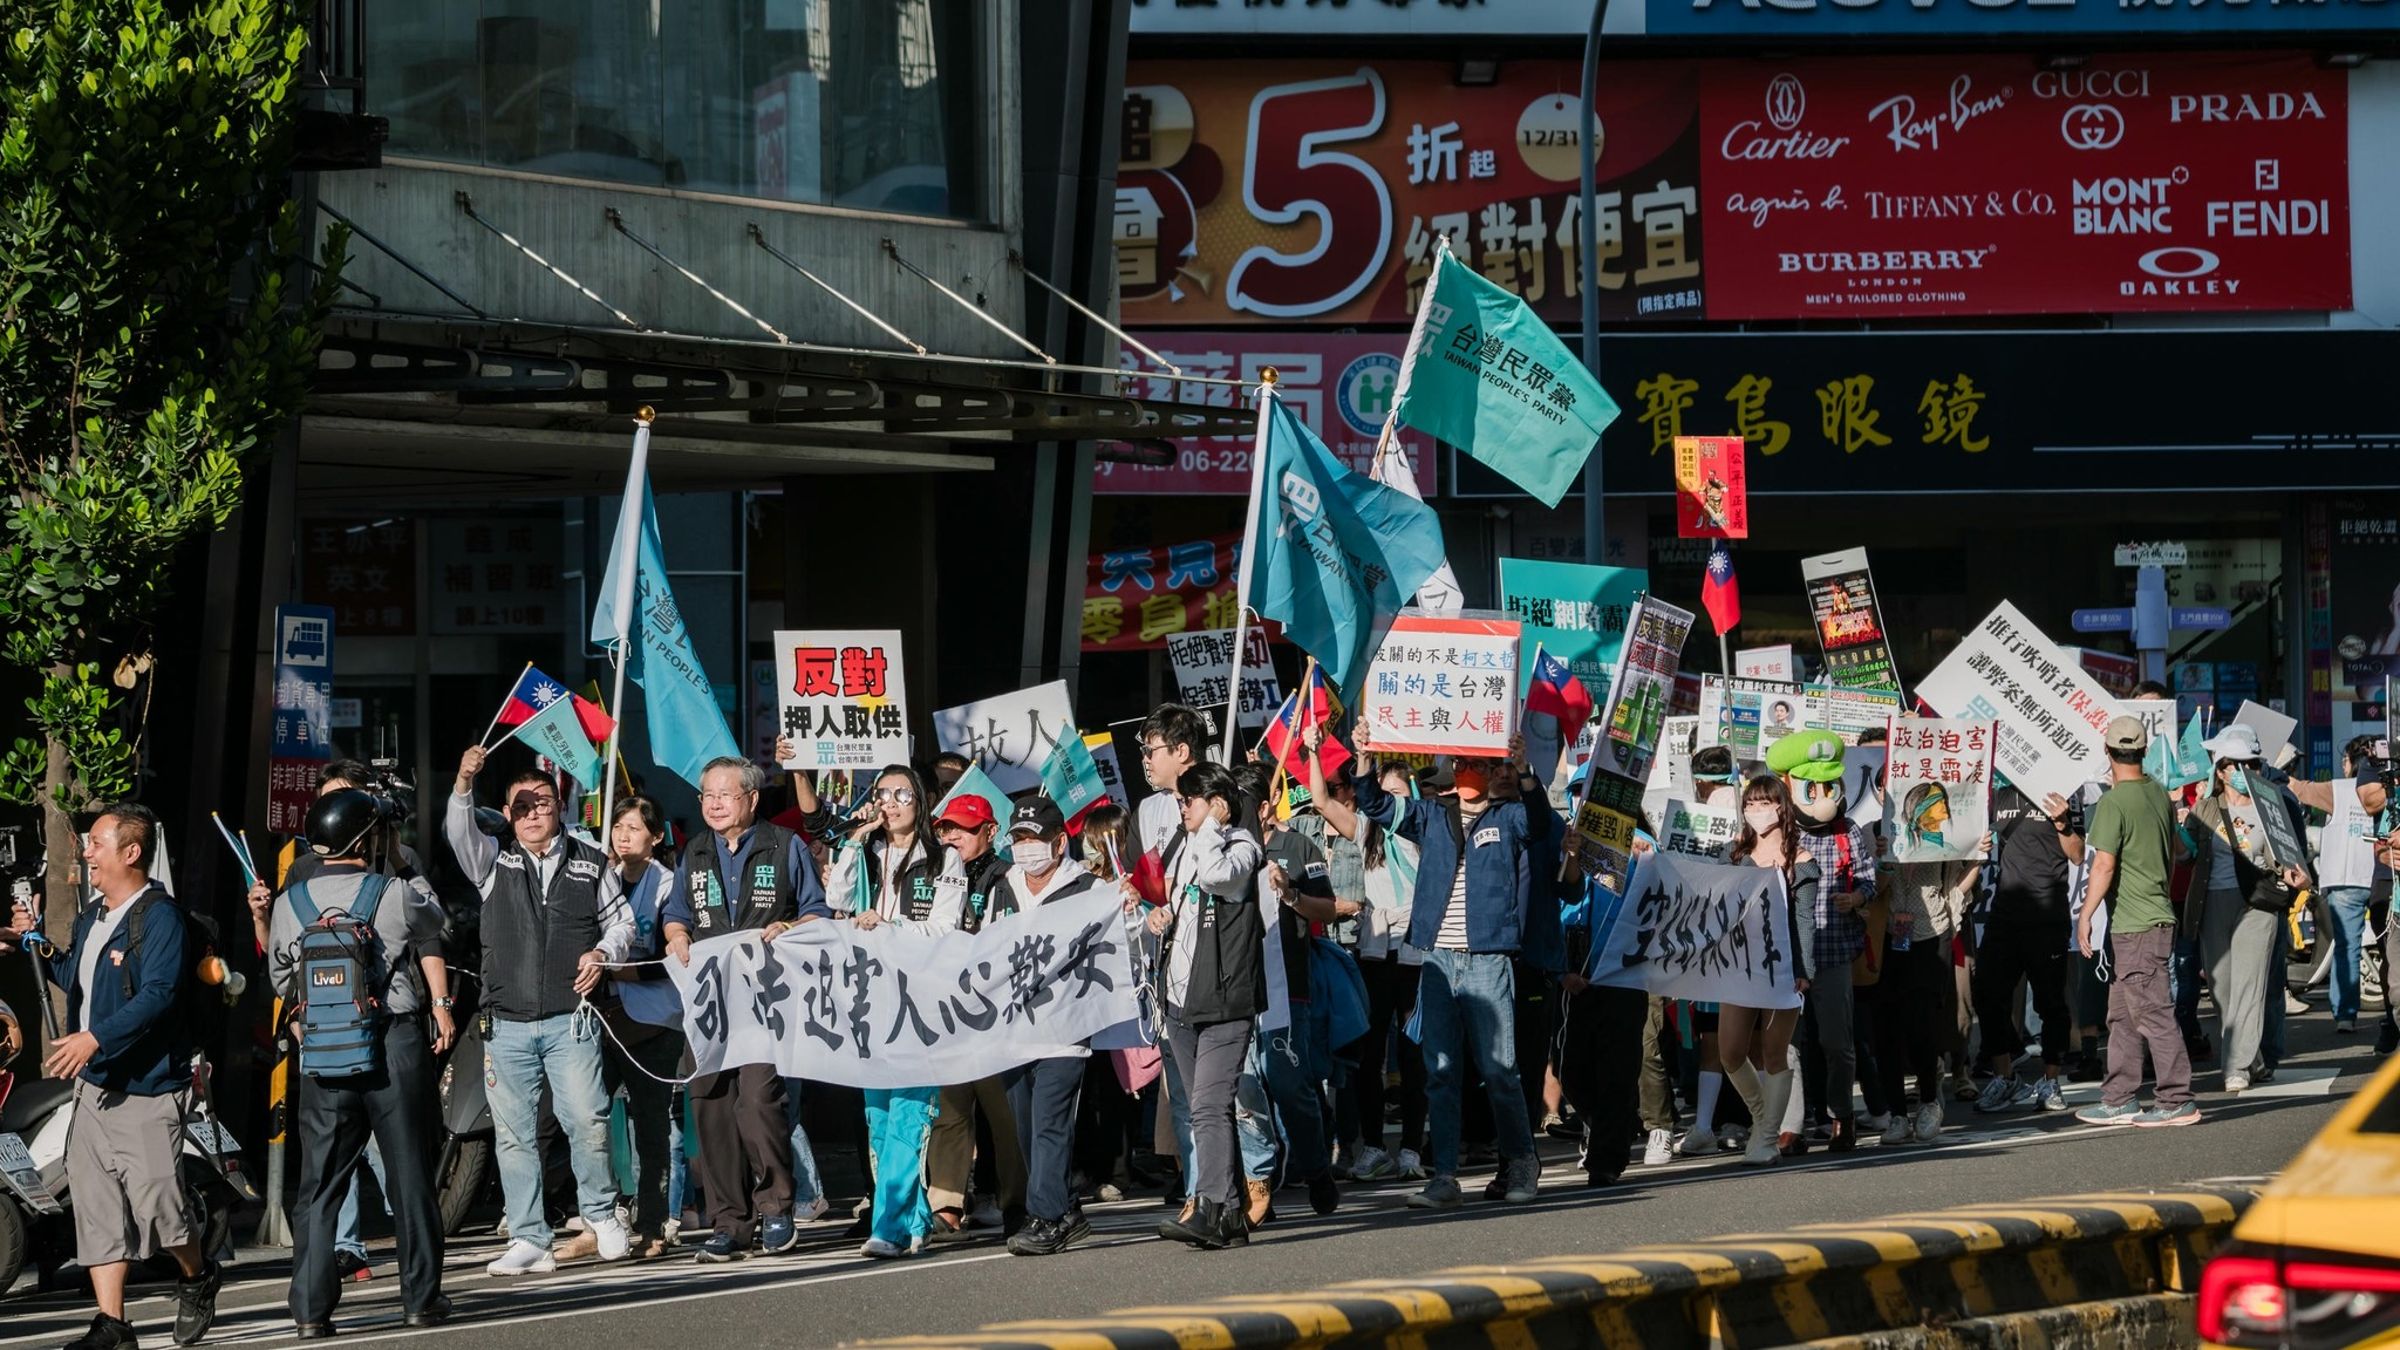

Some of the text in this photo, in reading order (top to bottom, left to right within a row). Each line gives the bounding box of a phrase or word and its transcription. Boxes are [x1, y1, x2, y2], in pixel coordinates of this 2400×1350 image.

[2032, 71, 2150, 98] GUCCI
[2169, 93, 2325, 122] PRADA
[1722, 120, 1849, 160] Cartier
[1864, 191, 1976, 218] TIFFANY
[1985, 193, 2005, 216] &
[2072, 178, 2172, 205] MONT
[2073, 207, 2172, 234] BLANC
[2207, 201, 2329, 237] FENDI
[1779, 249, 1989, 273] BURBERRY
[1848, 277, 1922, 287] LONDON
[2120, 279, 2240, 296] OAKLEY
[1806, 290, 1966, 304] MEN'S TAILORED CLOTHING
[1451, 323, 1577, 412] 台灣民眾黨
[1443, 350, 1567, 426] TAIWAN PEOPLE'S PARTY
[1634, 372, 1990, 456] 寶島眼鏡
[1297, 537, 1345, 578] TAIWAN
[1507, 594, 1632, 633] 拒絕網路霸
[656, 641, 710, 695] PEOPLE'S
[793, 646, 888, 698] 反對
[1378, 672, 1506, 701] 關的是台灣
[1377, 706, 1505, 734] 民主與人權
[1966, 649, 2090, 762] 讓弊案無所遁形
[784, 704, 902, 739] 押人取供
[1894, 726, 1987, 753] 政治迫害
[936, 875, 967, 887] 法不公
[314, 972, 344, 986] LiveU
